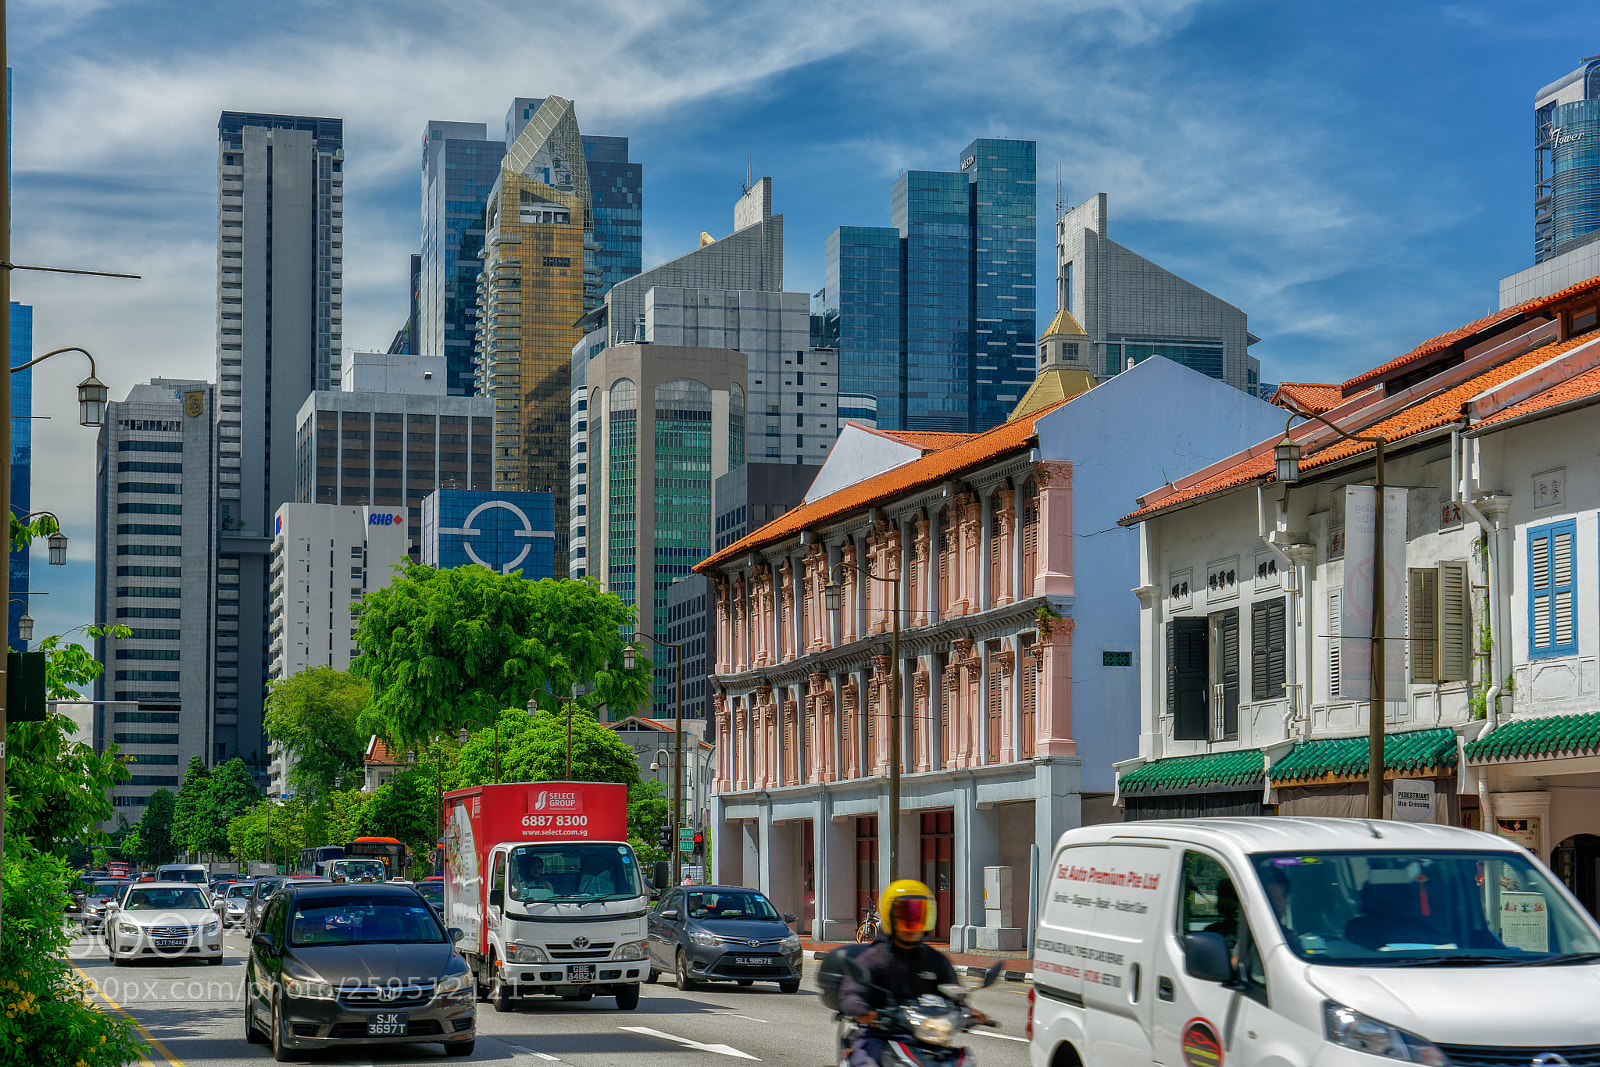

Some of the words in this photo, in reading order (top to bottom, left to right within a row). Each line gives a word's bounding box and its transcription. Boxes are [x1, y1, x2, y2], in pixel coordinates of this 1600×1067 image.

[1551, 127, 1585, 149] Tower
[368, 513, 393, 526] RHB
[549, 792, 575, 800] SELECT
[1397, 791, 1430, 799] PEDESTRIANS
[549, 799, 576, 807] GROUP
[1409, 801, 1430, 809] Crossing
[521, 815, 551, 827] 6887
[556, 815, 588, 827] 8300
[521, 828, 588, 837] www.select.com.sg
[573, 965, 590, 973] GBE
[568, 972, 595, 980] 3482Y
[376, 1014, 398, 1024] SJK
[369, 1024, 406, 1034] 3697T
